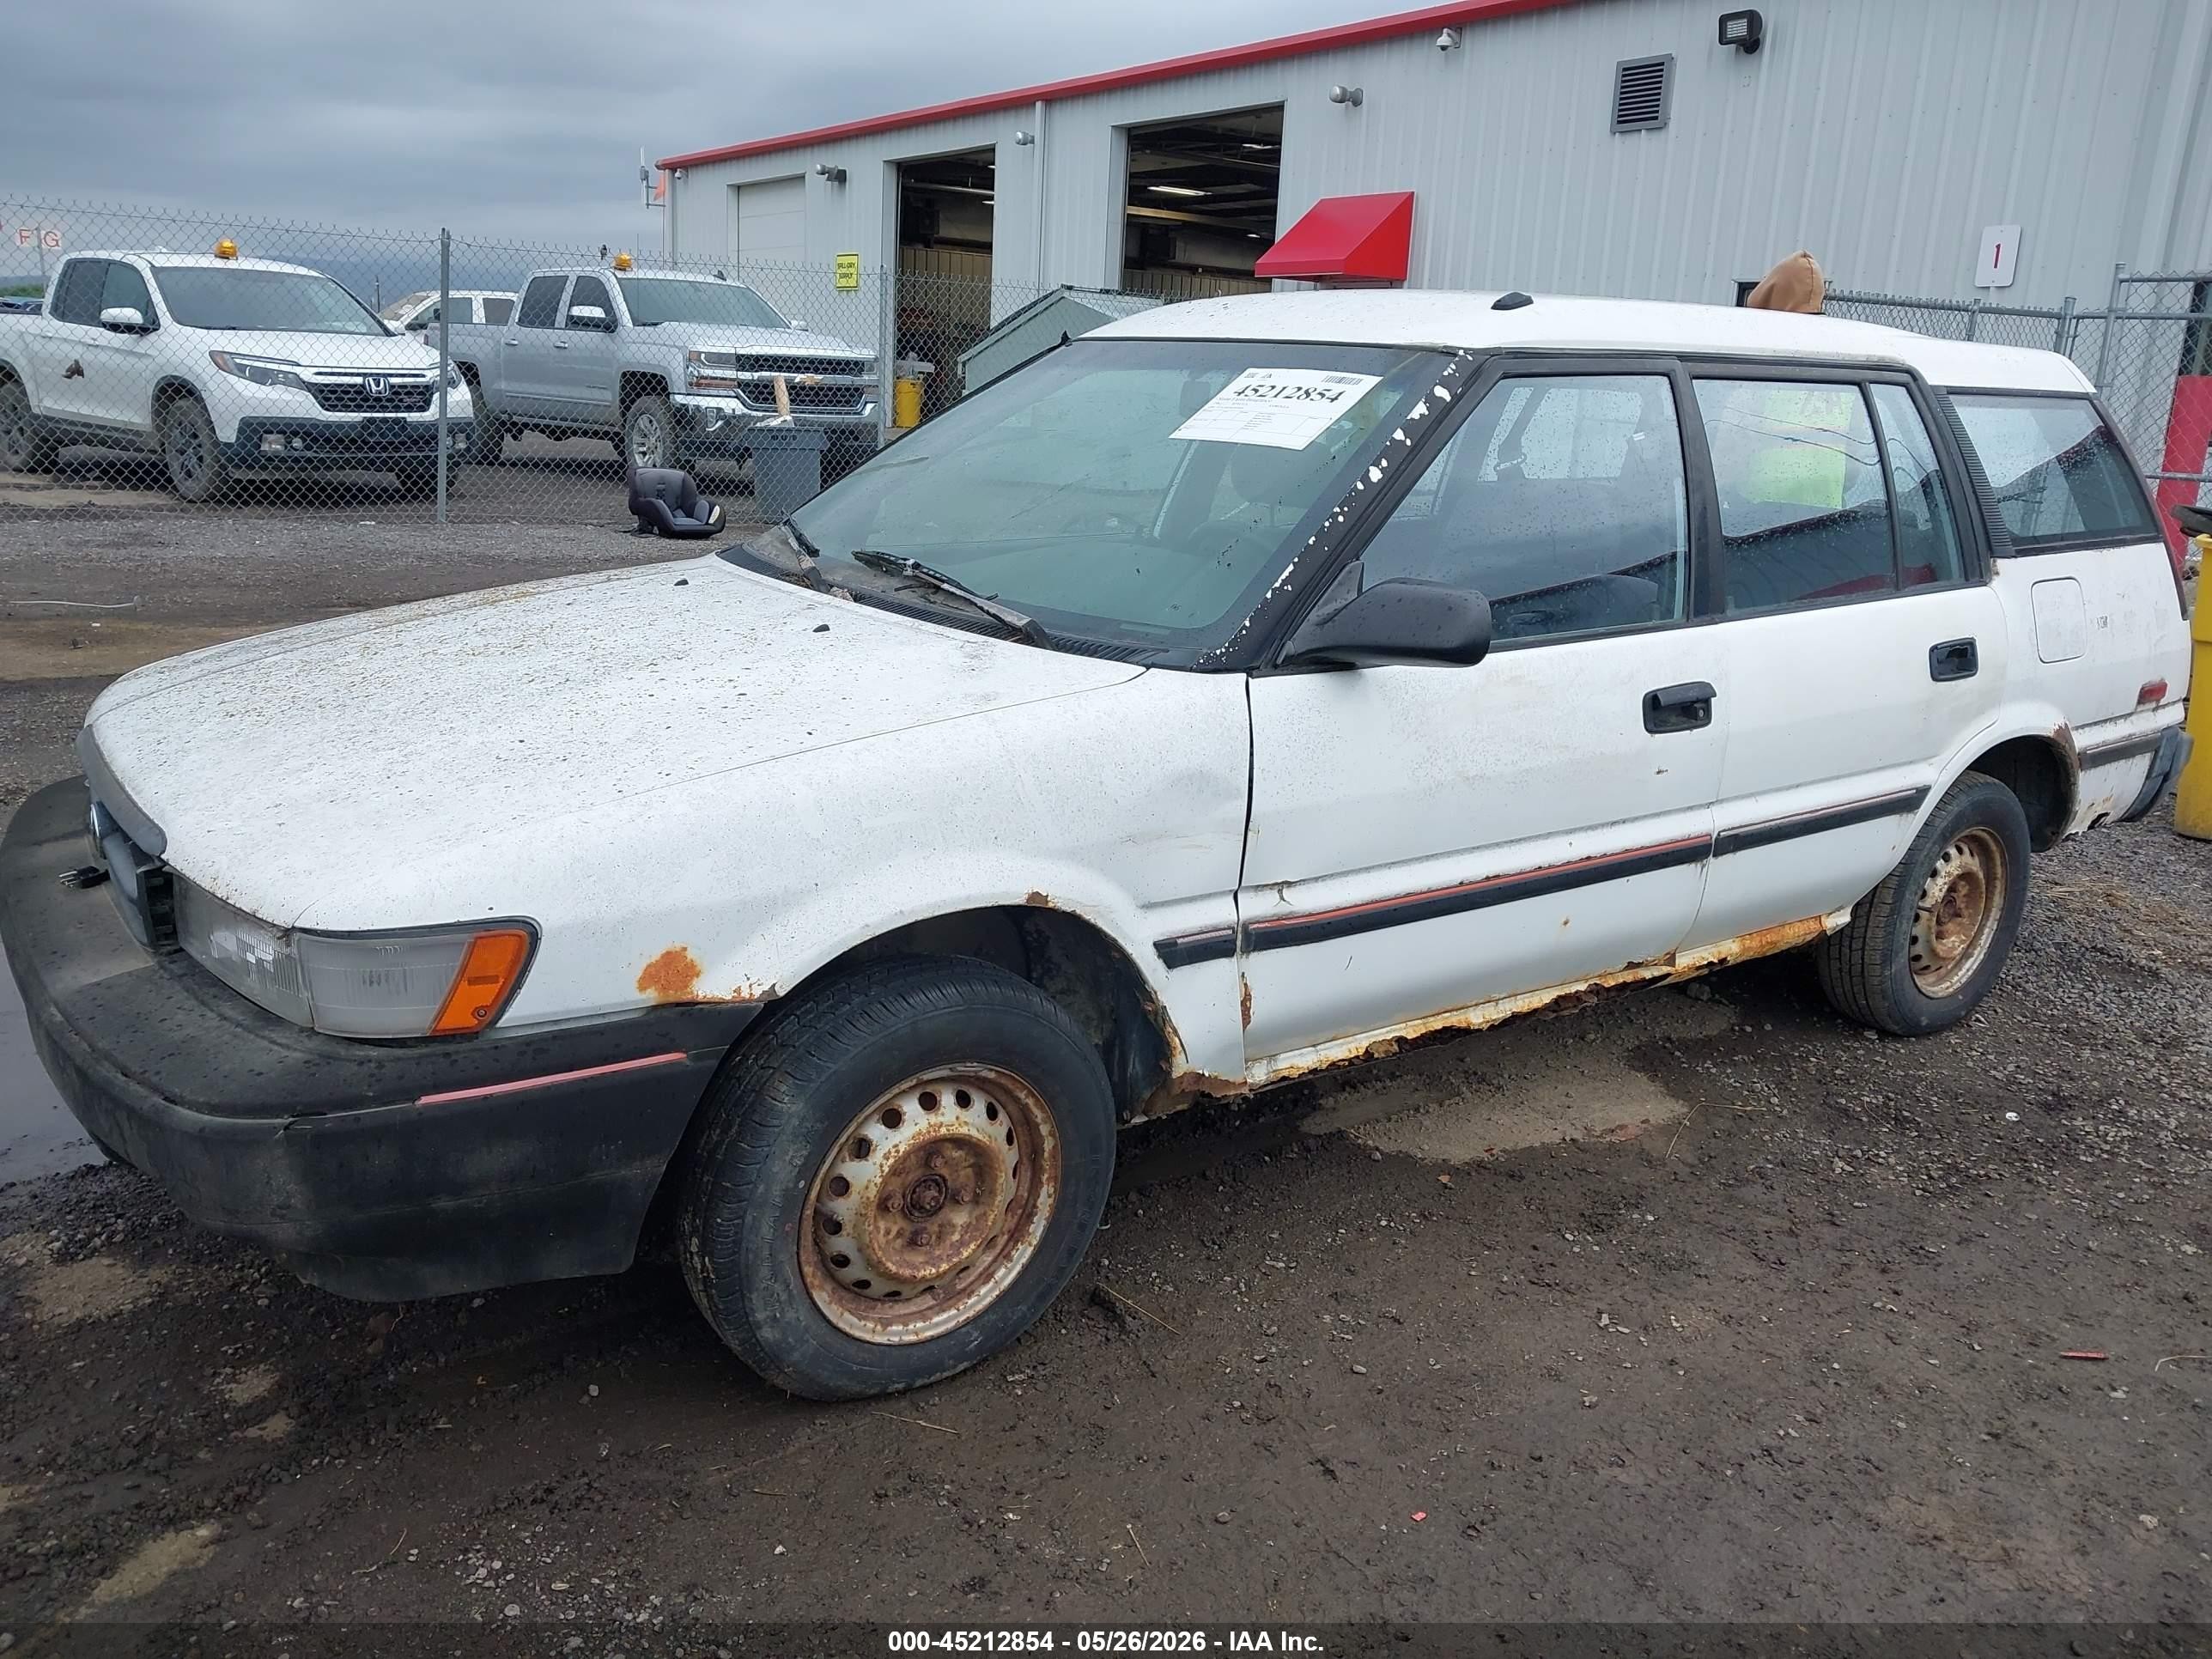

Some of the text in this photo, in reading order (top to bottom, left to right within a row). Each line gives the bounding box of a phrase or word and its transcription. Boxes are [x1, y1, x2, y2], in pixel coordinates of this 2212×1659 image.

[44, 231, 60, 247] G
[1993, 243, 2002, 269] 1
[1233, 384, 1346, 404] 45212854
